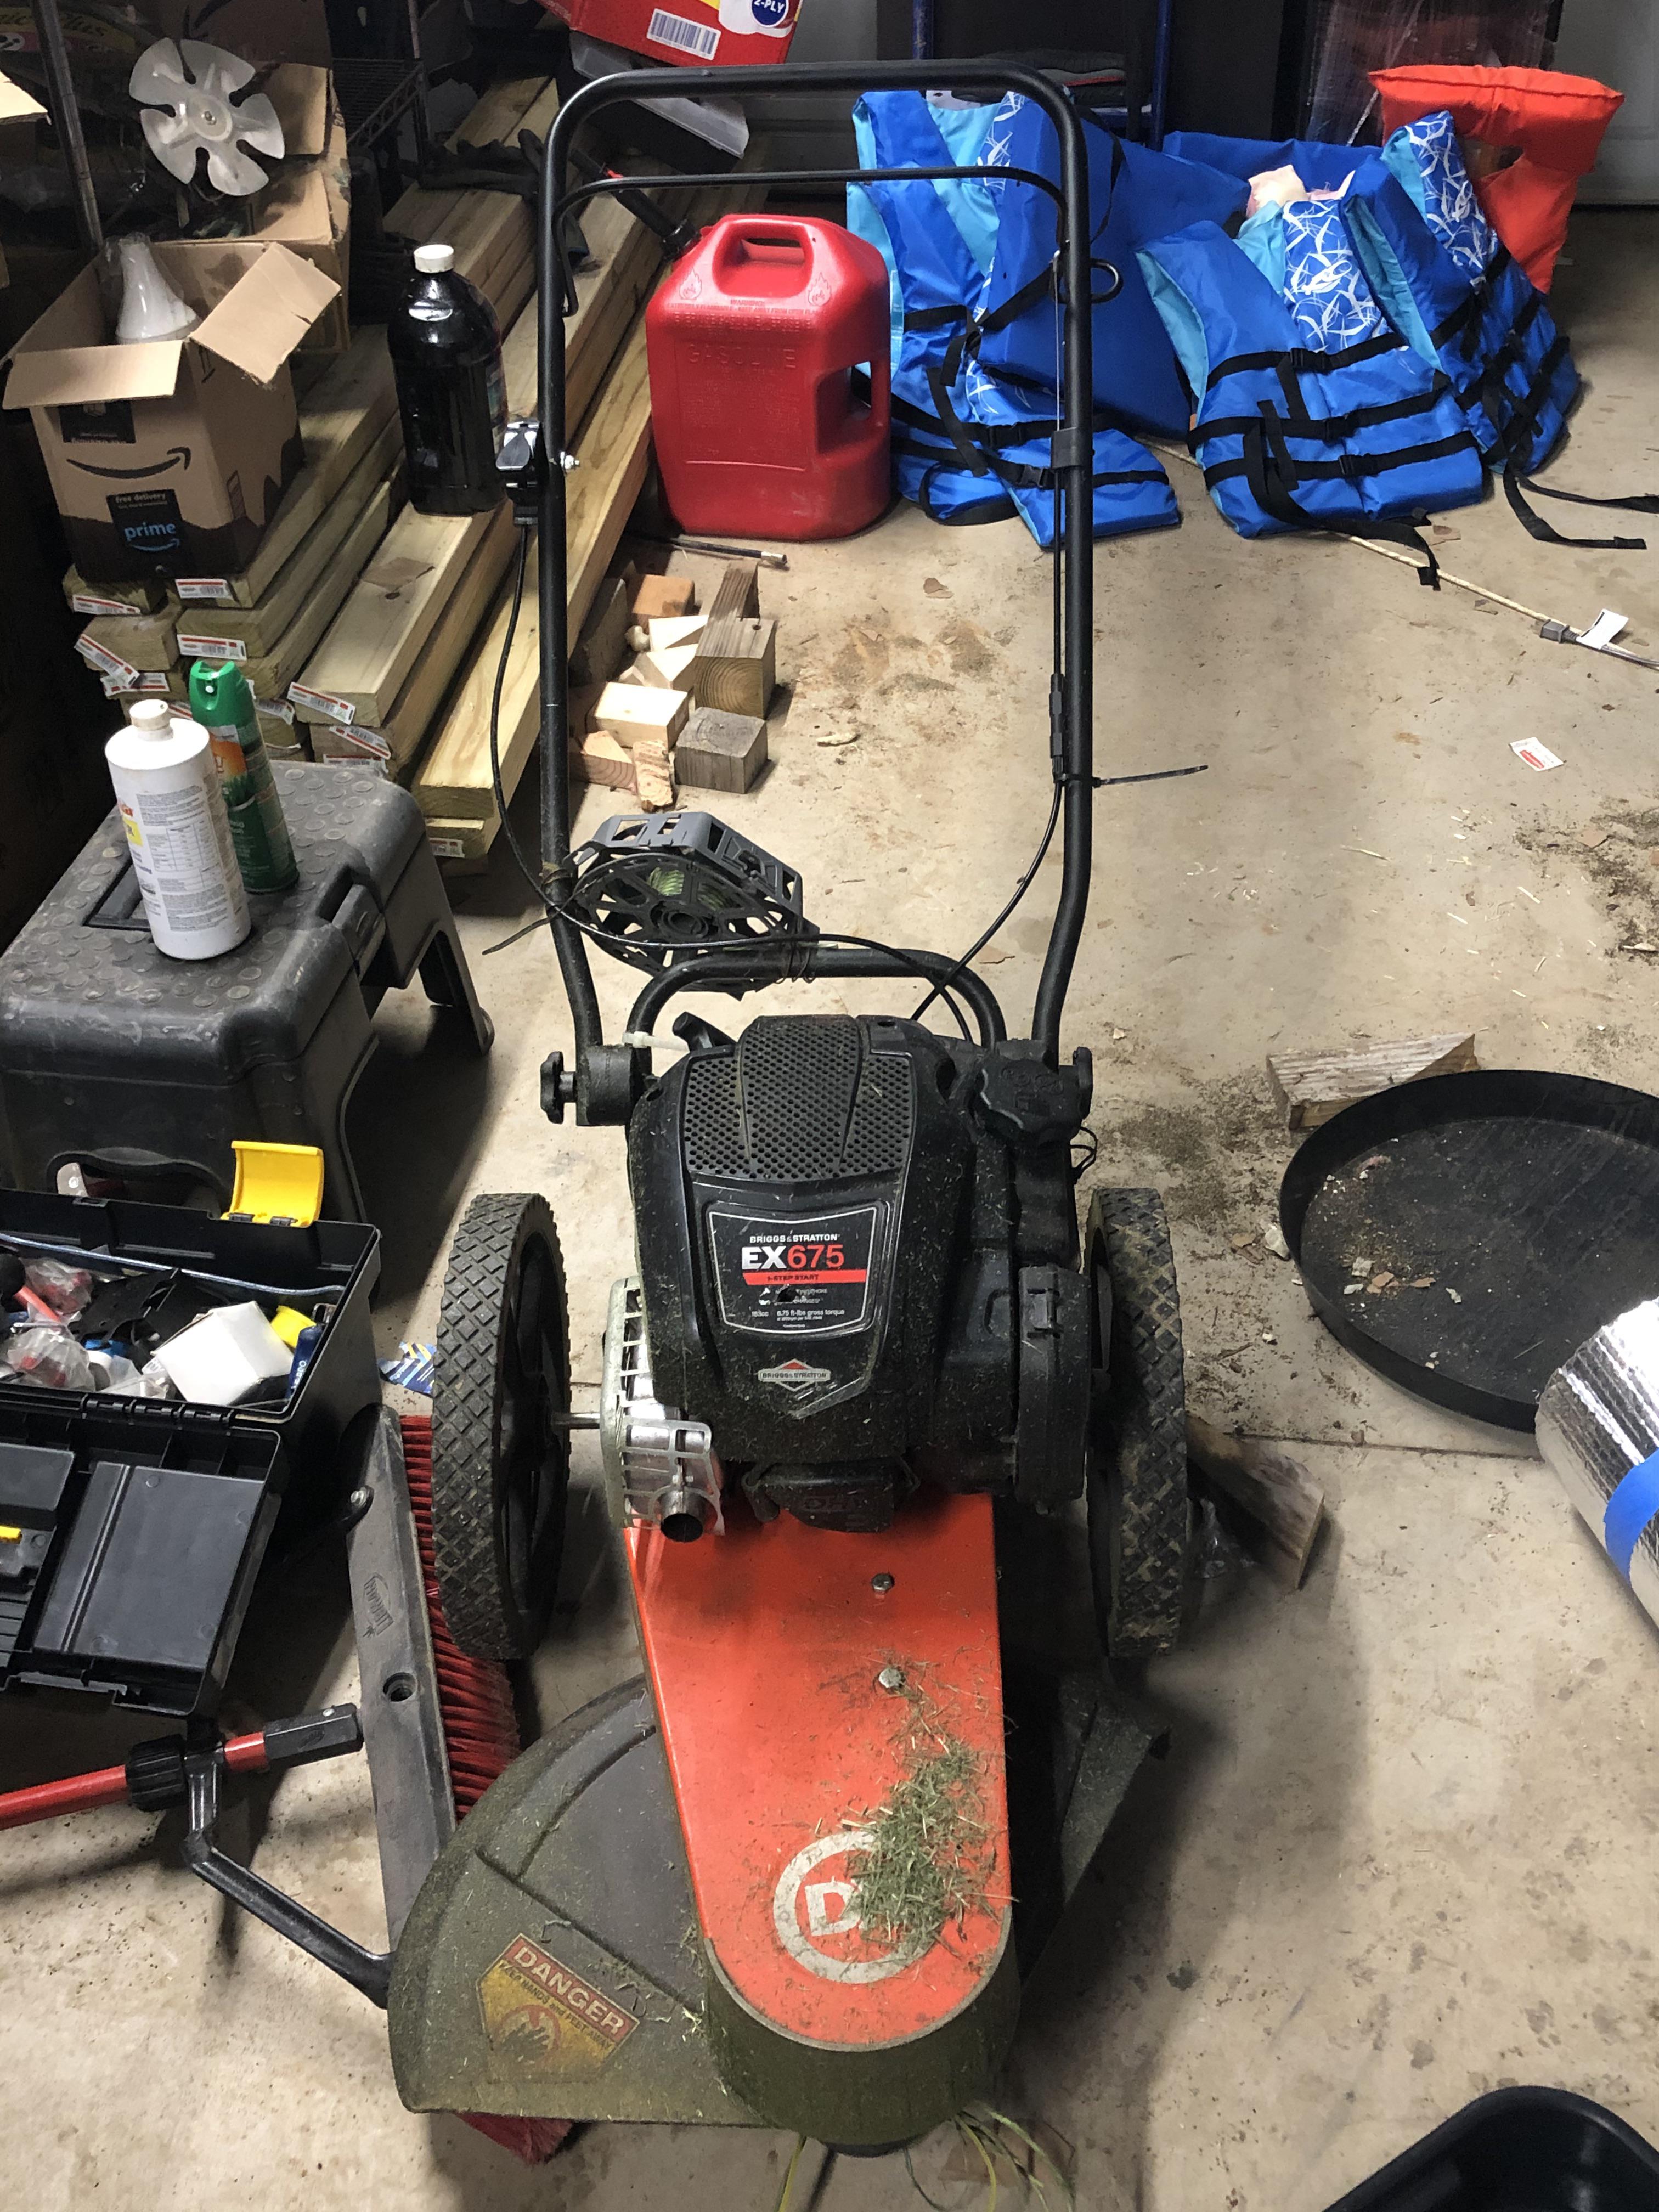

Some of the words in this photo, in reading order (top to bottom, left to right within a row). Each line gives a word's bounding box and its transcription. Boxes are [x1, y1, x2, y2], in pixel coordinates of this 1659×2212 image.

[124, 522, 176, 541] prime
[741, 1244, 845, 1270] EX675
[514, 1946, 624, 2034] DANGER
[521, 1978, 550, 2003] HANDS
[549, 2003, 566, 2016] and
[566, 2012, 587, 2031] FEET
[586, 2030, 612, 2050] AWAY
